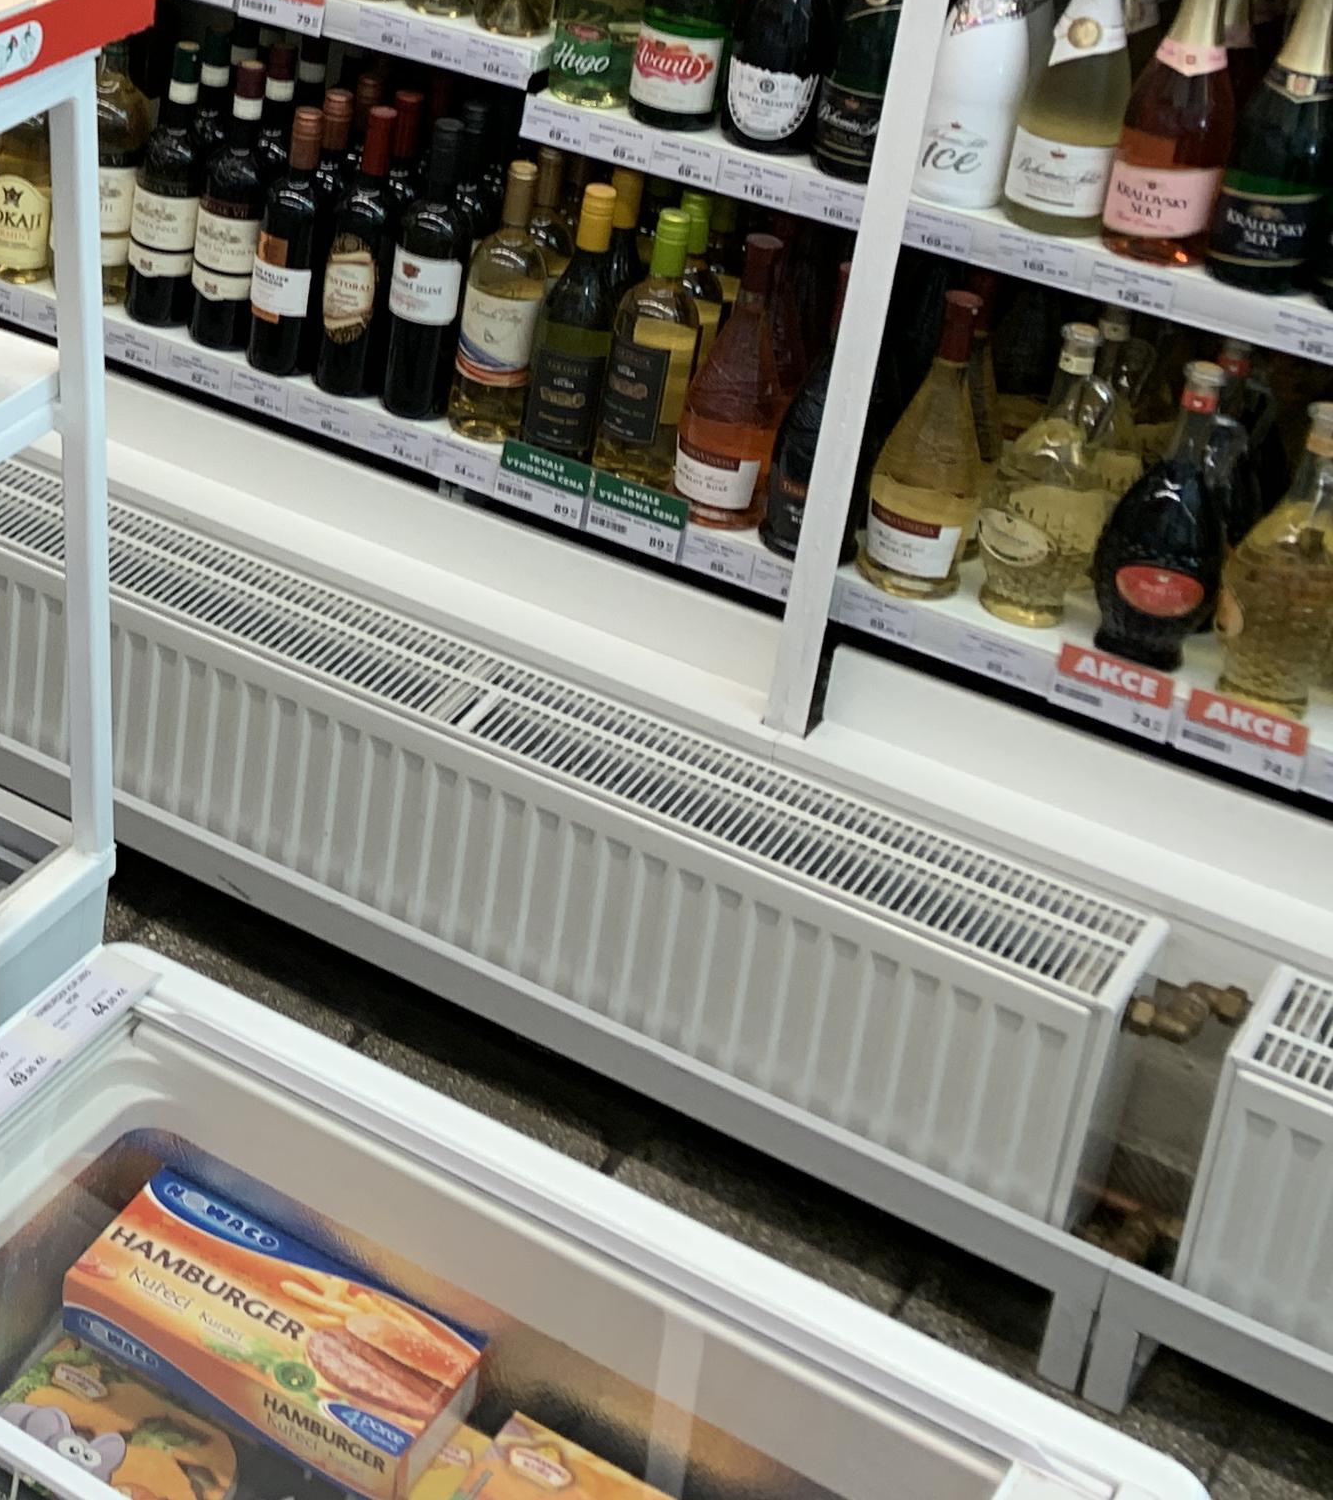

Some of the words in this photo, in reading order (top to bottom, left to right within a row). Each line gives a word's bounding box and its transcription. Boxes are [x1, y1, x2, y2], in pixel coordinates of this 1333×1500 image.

[552, 41, 611, 75] Hugo
[528, 452, 565, 473] TRVALE
[621, 485, 661, 507] TRVALE
[1074, 655, 1159, 699] AKCE
[1204, 701, 1293, 747] AKCE
[109, 1225, 306, 1342] HAMBURGER
[262, 1392, 387, 1475] HAMBURGER
